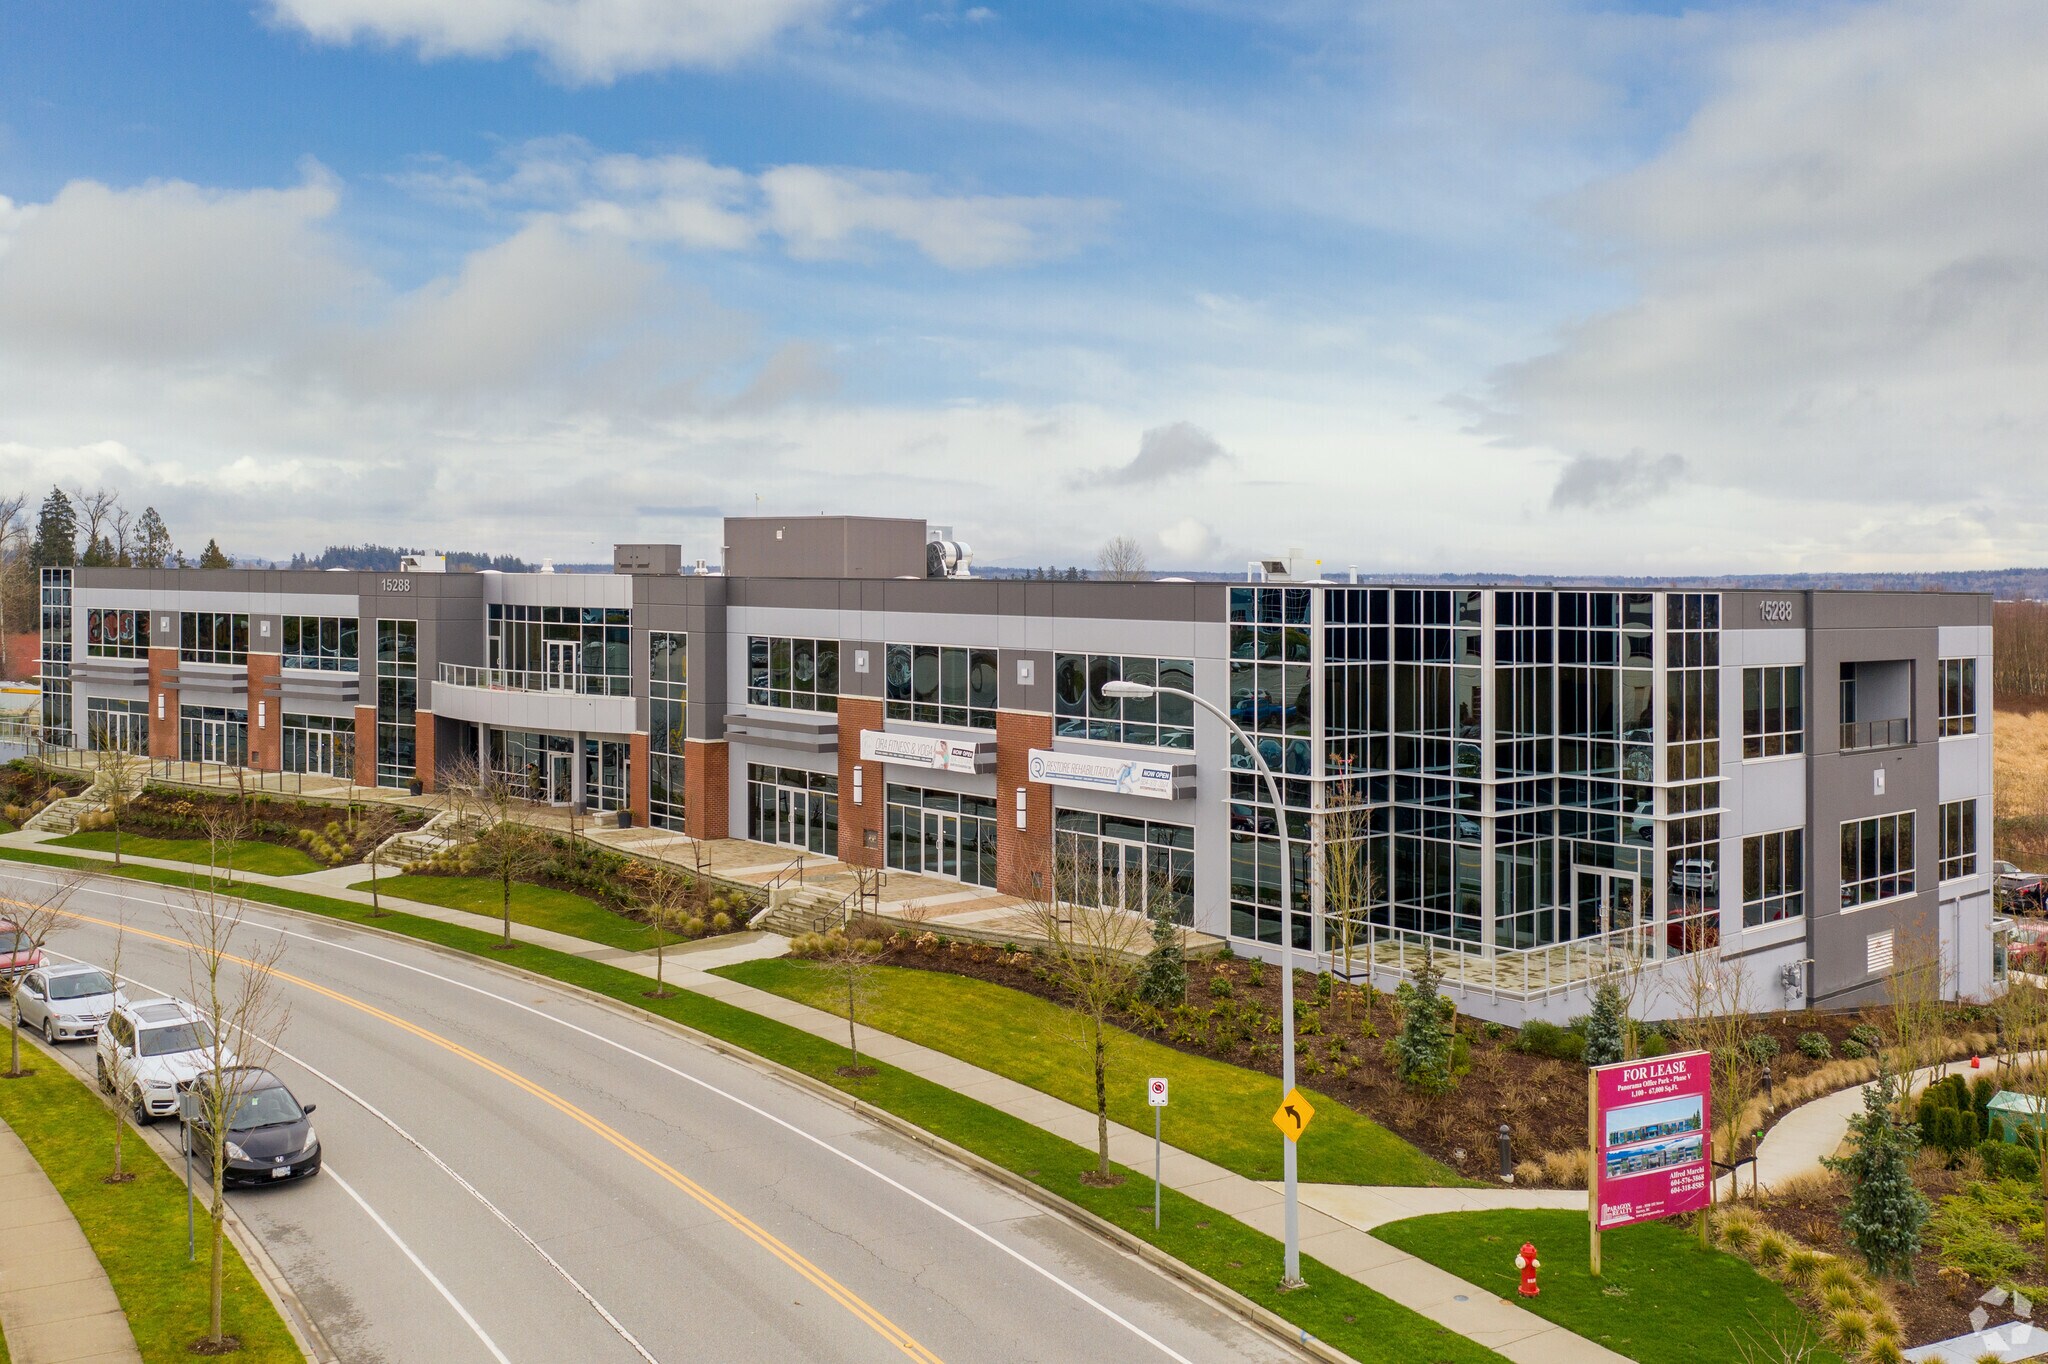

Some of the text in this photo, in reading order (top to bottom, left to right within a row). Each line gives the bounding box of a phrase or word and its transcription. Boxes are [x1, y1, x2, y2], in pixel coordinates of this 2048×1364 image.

[381, 578, 410, 592] 15288
[1760, 600, 1792, 620] 15288
[888, 739, 910, 753] FITNESS
[911, 742, 916, 754] &
[917, 744, 933, 756] YOGA
[962, 750, 972, 758] OPEN
[1046, 760, 1116, 778] RESTORE REHABILITATION
[1155, 771, 1169, 779] OPEN
[1623, 1060, 1686, 1082] FOR LEASE
[1617, 1083, 1642, 1091] Panorama
[1643, 1079, 1657, 1087] Office
[1658, 1077, 1669, 1085] Park
[1673, 1074, 1687, 1082] Phase
[1670, 1170, 1686, 1179] Alfred
[1607, 1202, 1631, 1212] PARAGON
[1612, 1207, 1632, 1217] REALTY
